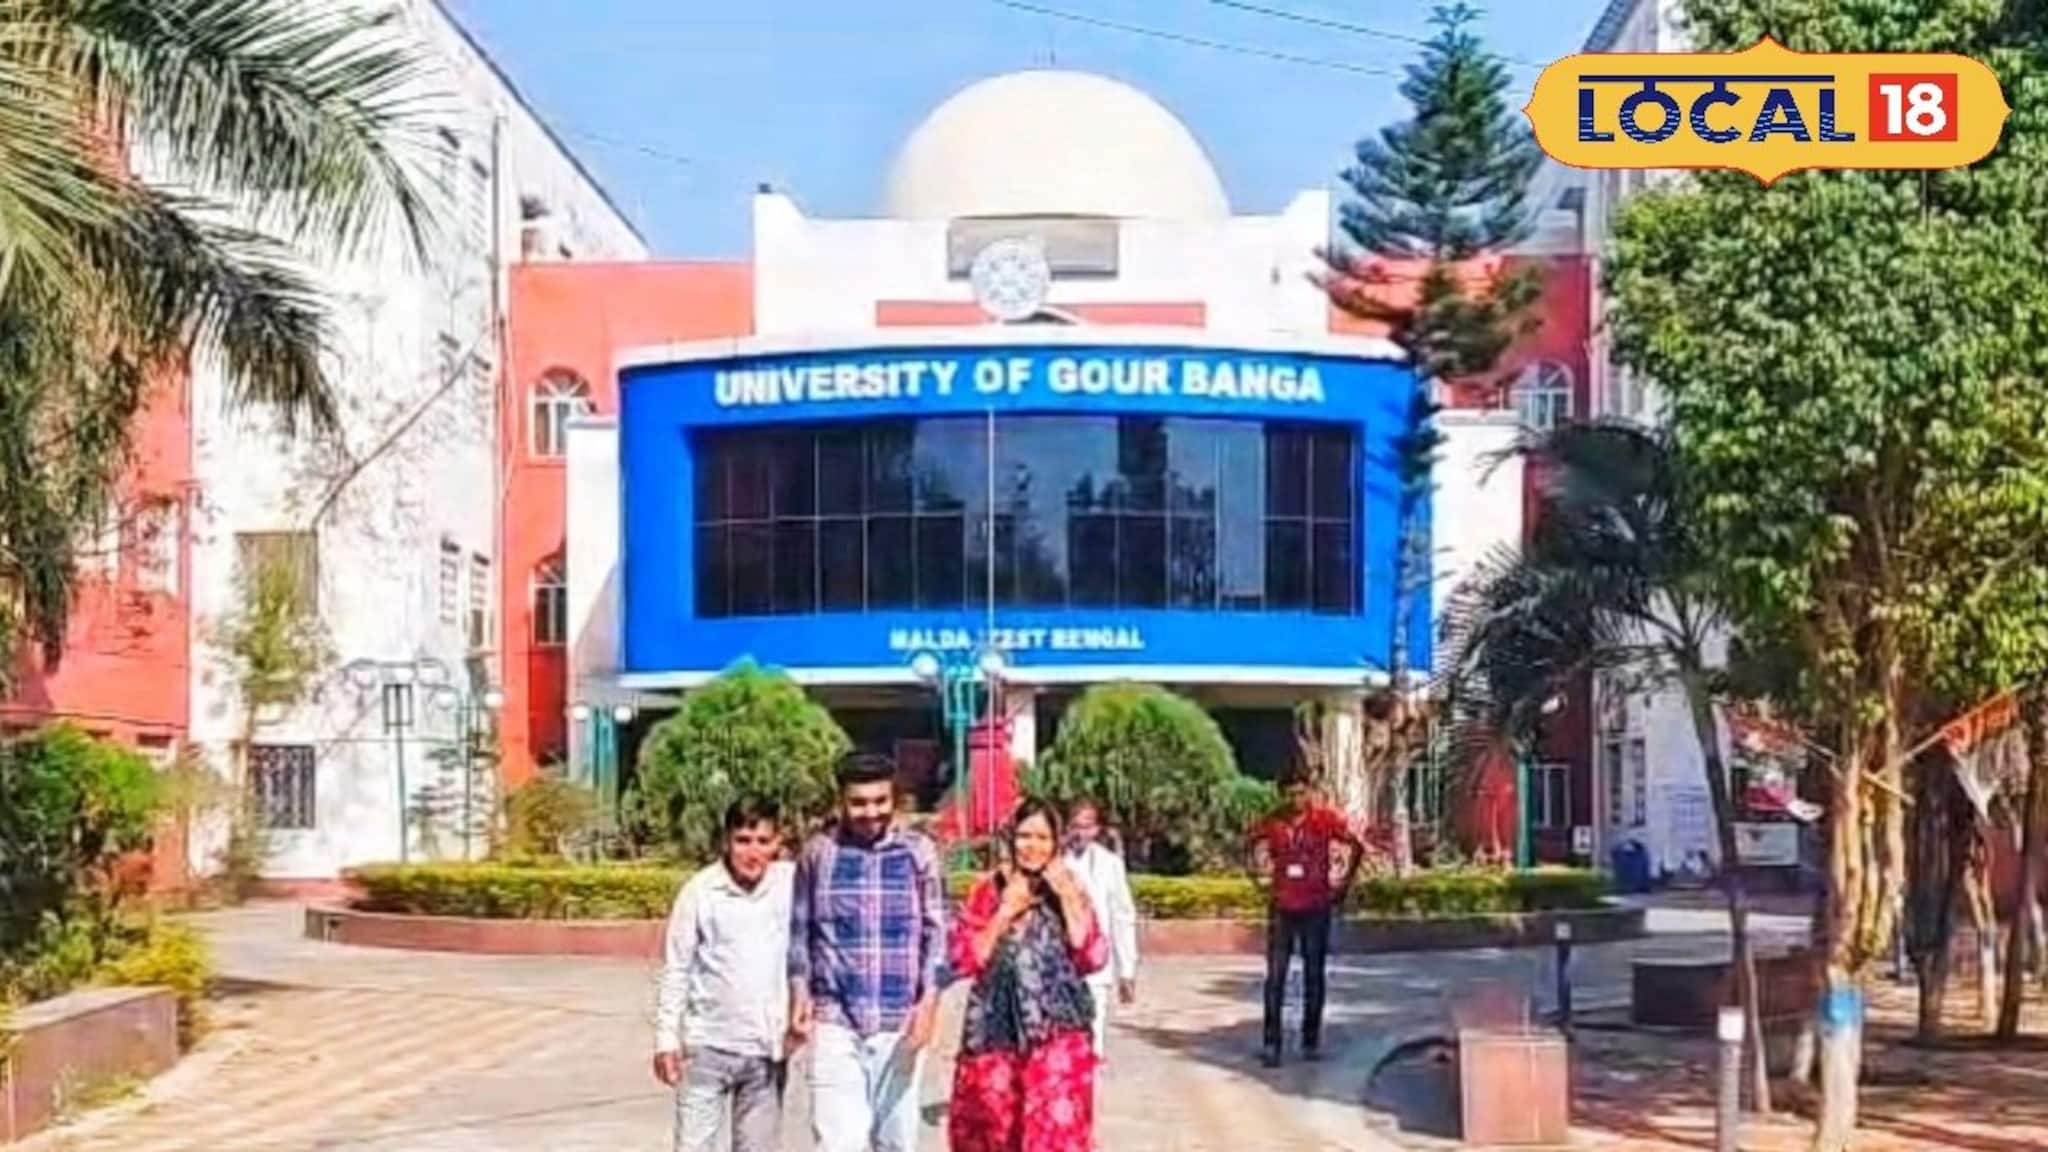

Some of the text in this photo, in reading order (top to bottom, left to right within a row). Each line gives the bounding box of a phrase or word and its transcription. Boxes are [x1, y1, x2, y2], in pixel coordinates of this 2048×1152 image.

[713, 358, 1326, 408] UNIVERSITY OF GOUR BANGA
[981, 629, 1049, 649] EST
